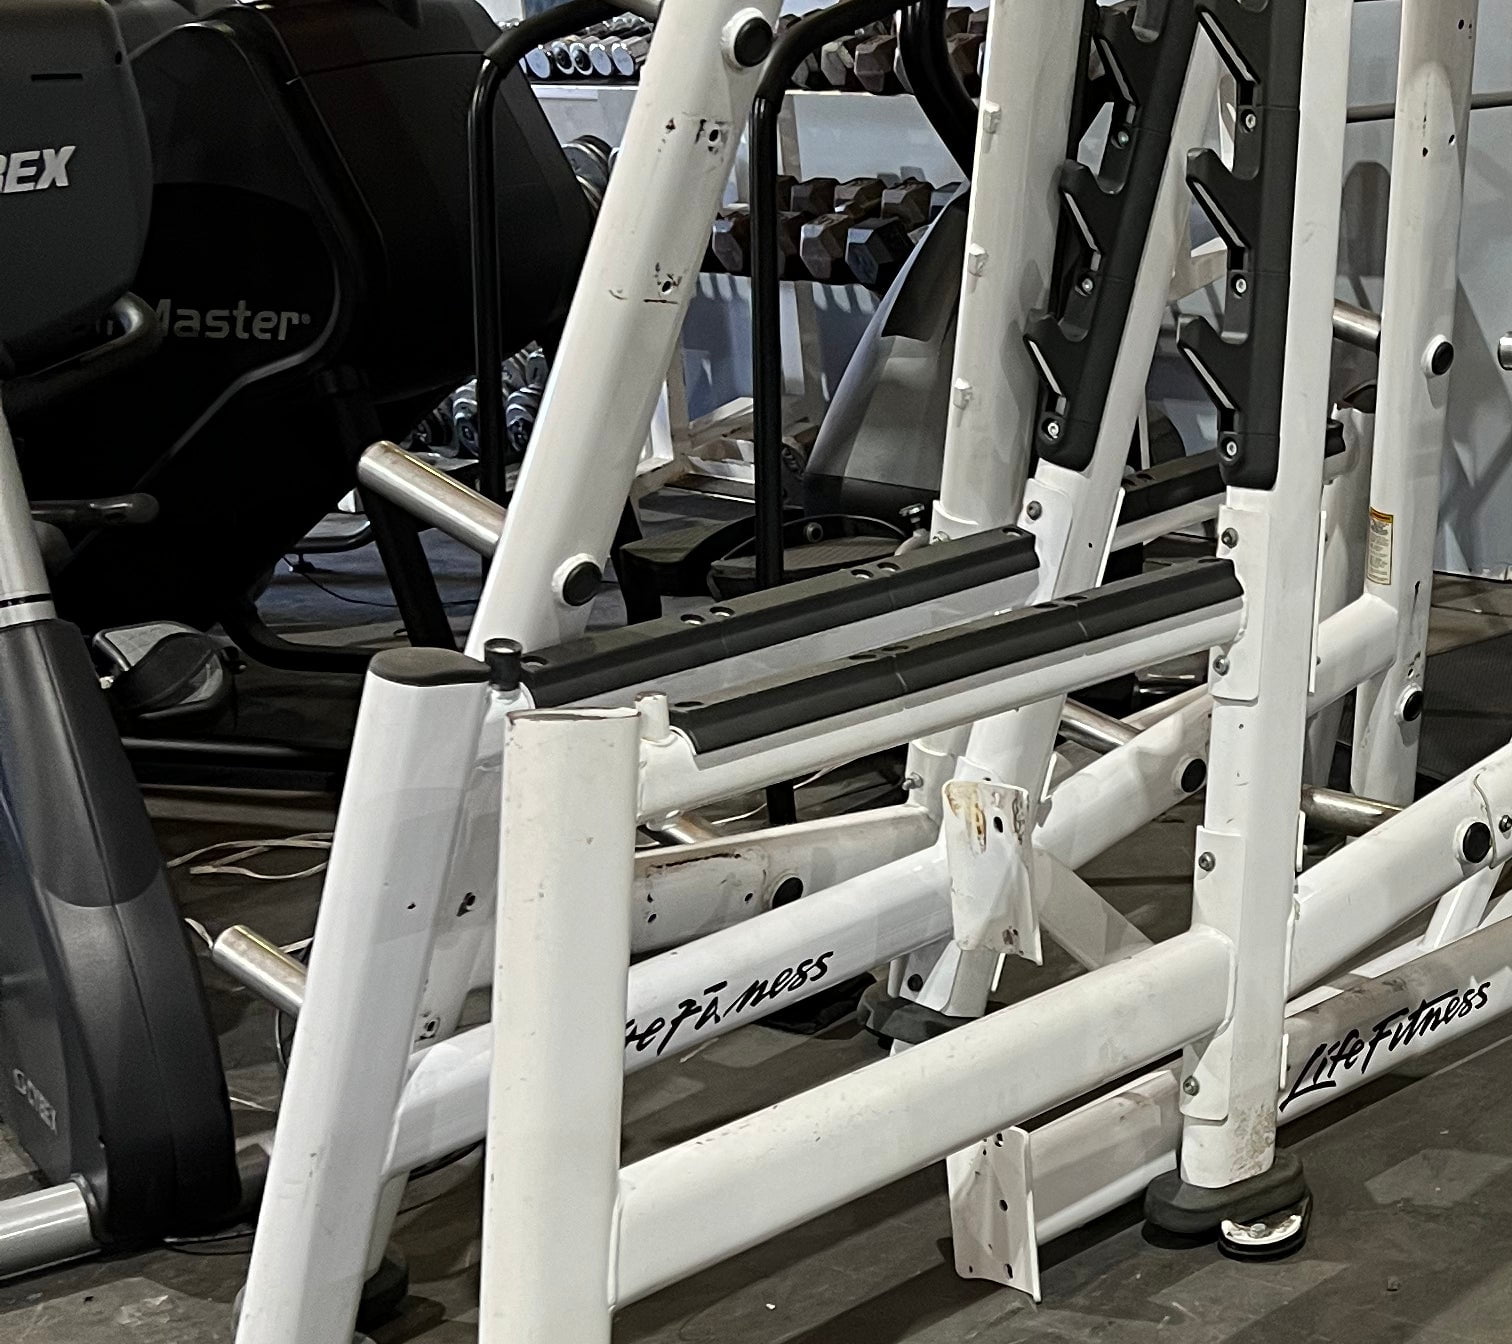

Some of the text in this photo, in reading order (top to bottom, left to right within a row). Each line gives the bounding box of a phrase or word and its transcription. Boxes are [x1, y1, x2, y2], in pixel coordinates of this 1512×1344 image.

[0, 145, 77, 194] EX
[1278, 981, 1491, 1113] Life Fitness
